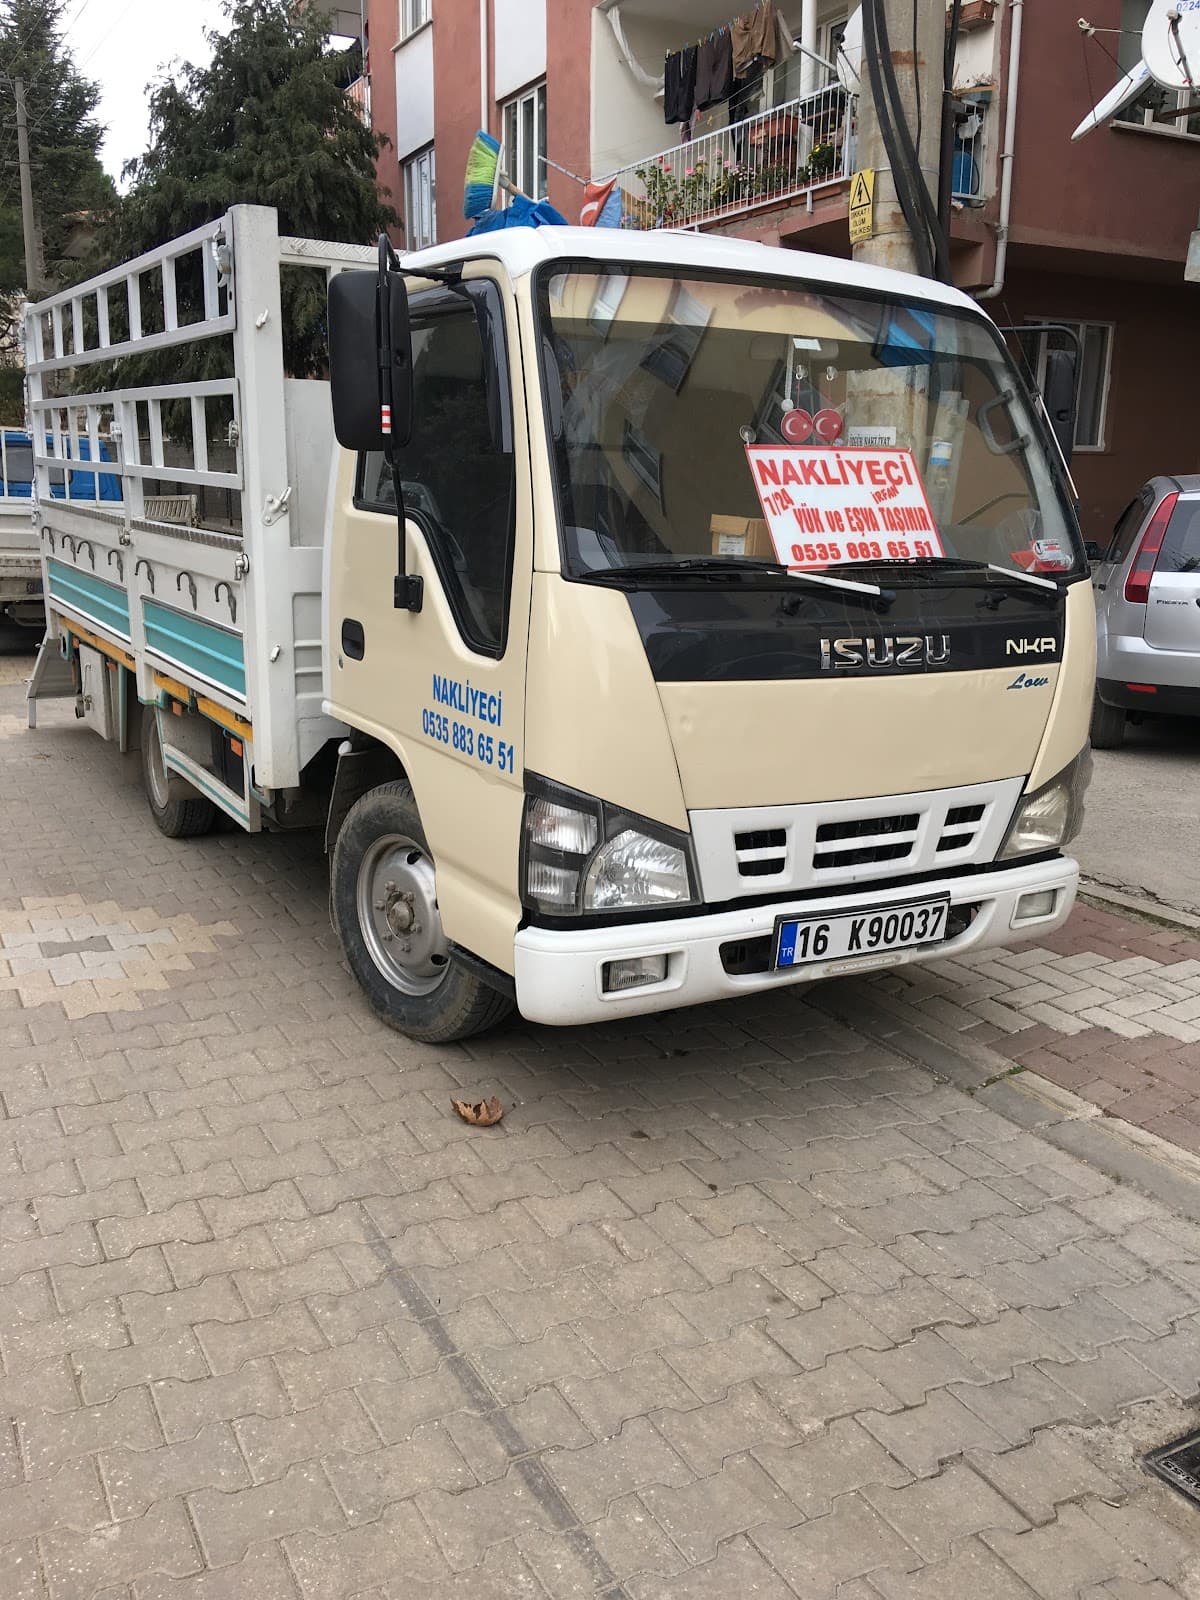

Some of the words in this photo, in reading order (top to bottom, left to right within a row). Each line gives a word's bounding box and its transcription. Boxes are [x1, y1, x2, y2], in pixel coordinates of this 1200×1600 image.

[763, 487, 795, 516] 7/24
[792, 502, 825, 533] YÜK
[844, 507, 880, 537] EŞYA
[878, 507, 931, 536] TAŞINIR
[791, 542, 842, 562] 0535
[846, 541, 882, 559] 883
[886, 541, 910, 558] 65
[914, 540, 933, 557] 51
[820, 635, 951, 669] ISUZU
[1006, 637, 1056, 655] NKR
[1006, 673, 1048, 690] Low
[432, 673, 502, 727] NAKLİYECİ
[422, 708, 449, 744] 0535
[452, 721, 474, 756] 883
[477, 733, 494, 765] 65
[497, 741, 514, 774] 51
[781, 946, 794, 957] TR
[799, 924, 830, 958] 16
